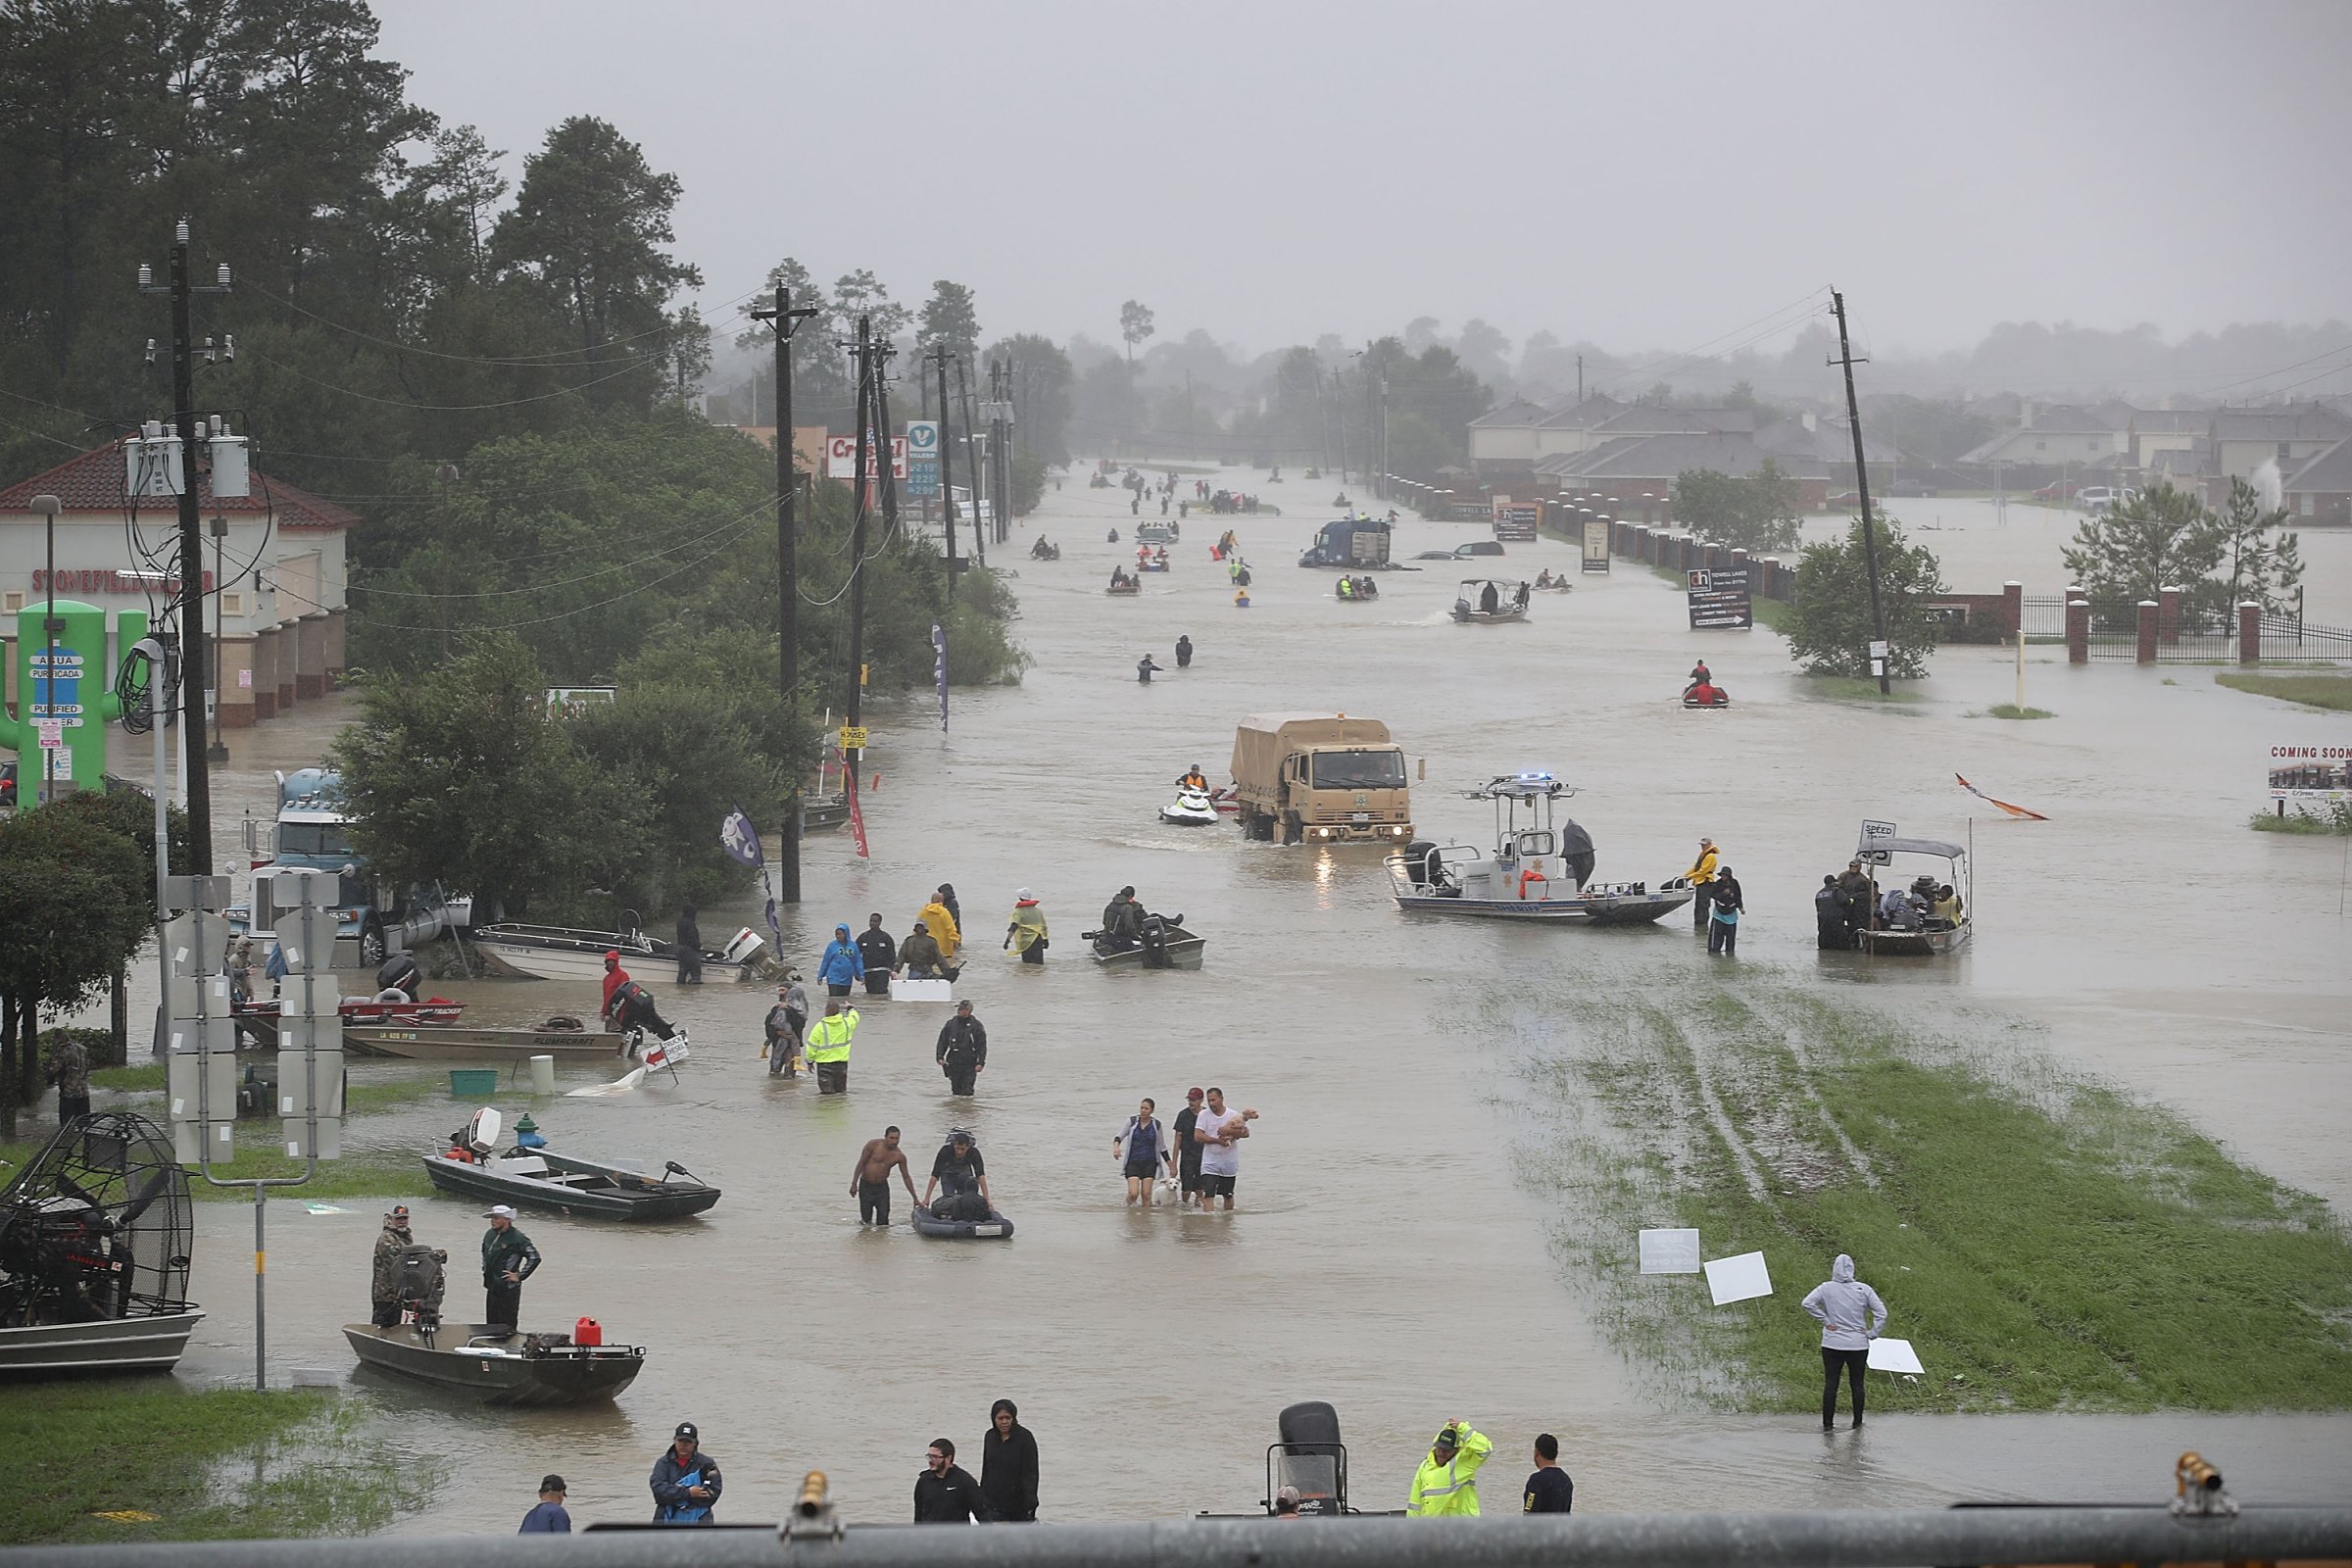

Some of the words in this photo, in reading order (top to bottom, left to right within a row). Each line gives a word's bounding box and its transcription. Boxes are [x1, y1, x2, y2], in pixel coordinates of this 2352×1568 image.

[833, 439, 902, 458] Crsl
[148, 570, 213, 596] LIQR
[32, 669, 79, 678] PURICADA
[34, 705, 77, 713] PUIFIED
[2271, 746, 2317, 759] COMING
[2321, 747, 2352, 760] SOON
[1865, 824, 1892, 835] SPEED
[532, 1037, 596, 1046] ALUMACRAFT
[662, 1036, 682, 1049] TRUCK
[666, 1044, 685, 1055] DIESEL
